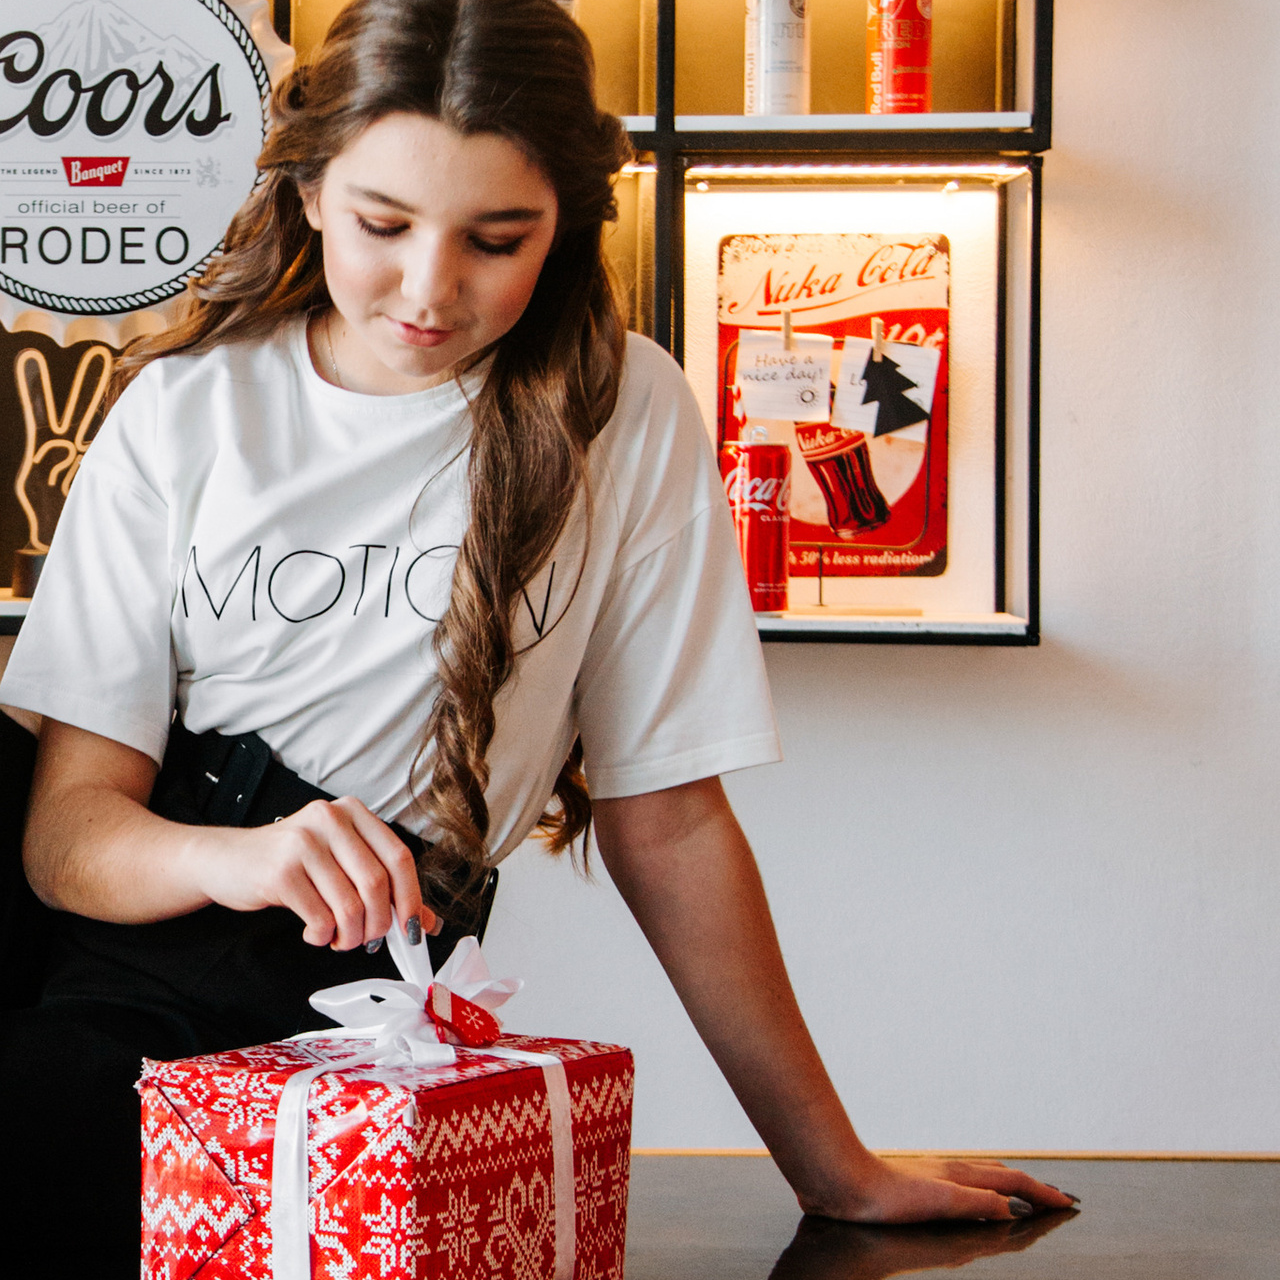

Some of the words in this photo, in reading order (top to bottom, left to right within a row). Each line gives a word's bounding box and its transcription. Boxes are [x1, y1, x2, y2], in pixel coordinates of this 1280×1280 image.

[71, 160, 124, 184] Banquet
[17, 200, 85, 214] official
[93, 200, 139, 214] beer
[146, 200, 166, 214] of
[0, 226, 190, 266] RODEO
[727, 264, 843, 315] Nuka
[857, 243, 935, 288] Cola
[754, 354, 796, 367] Have
[804, 356, 814, 365] a
[743, 368, 778, 382] nice
[785, 368, 824, 382] day!
[832, 550, 860, 566] less
